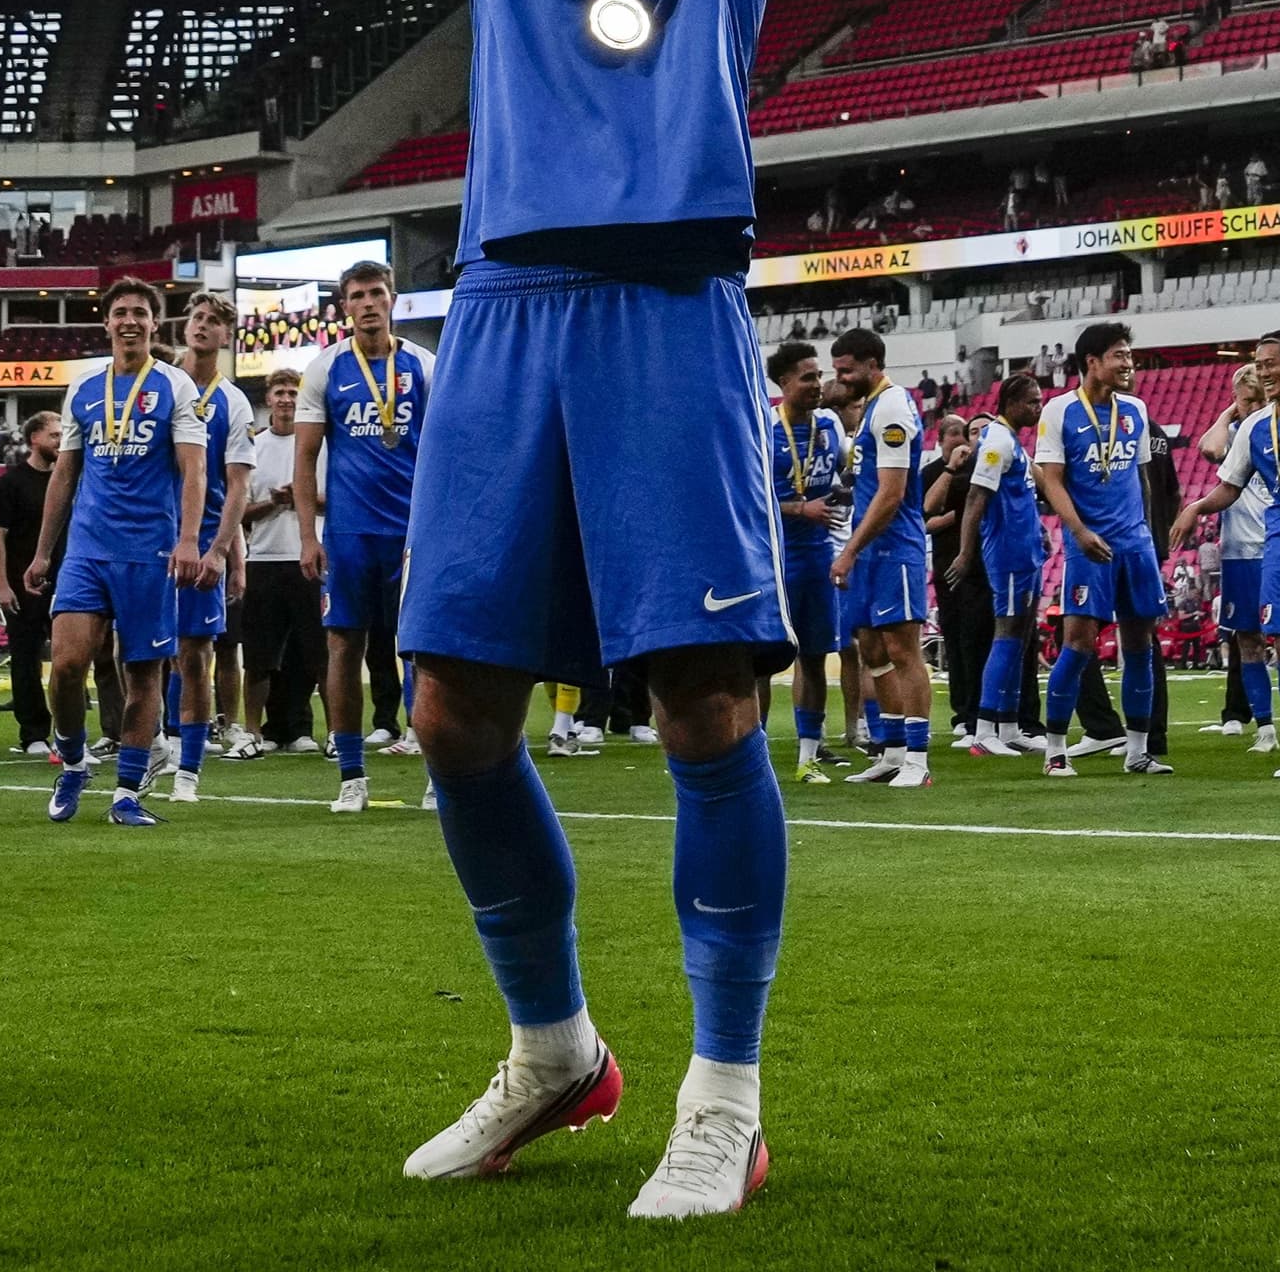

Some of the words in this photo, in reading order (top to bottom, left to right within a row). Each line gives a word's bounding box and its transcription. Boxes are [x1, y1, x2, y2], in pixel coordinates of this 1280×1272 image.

[191, 191, 239, 219] ASML
[1075, 225, 1136, 249] JOHAN
[1141, 217, 1215, 242] CRUIJFF
[804, 252, 884, 275] WINNAAR
[889, 249, 910, 268] AZ
[30, 367, 54, 381] AZ
[344, 401, 414, 425] AFS
